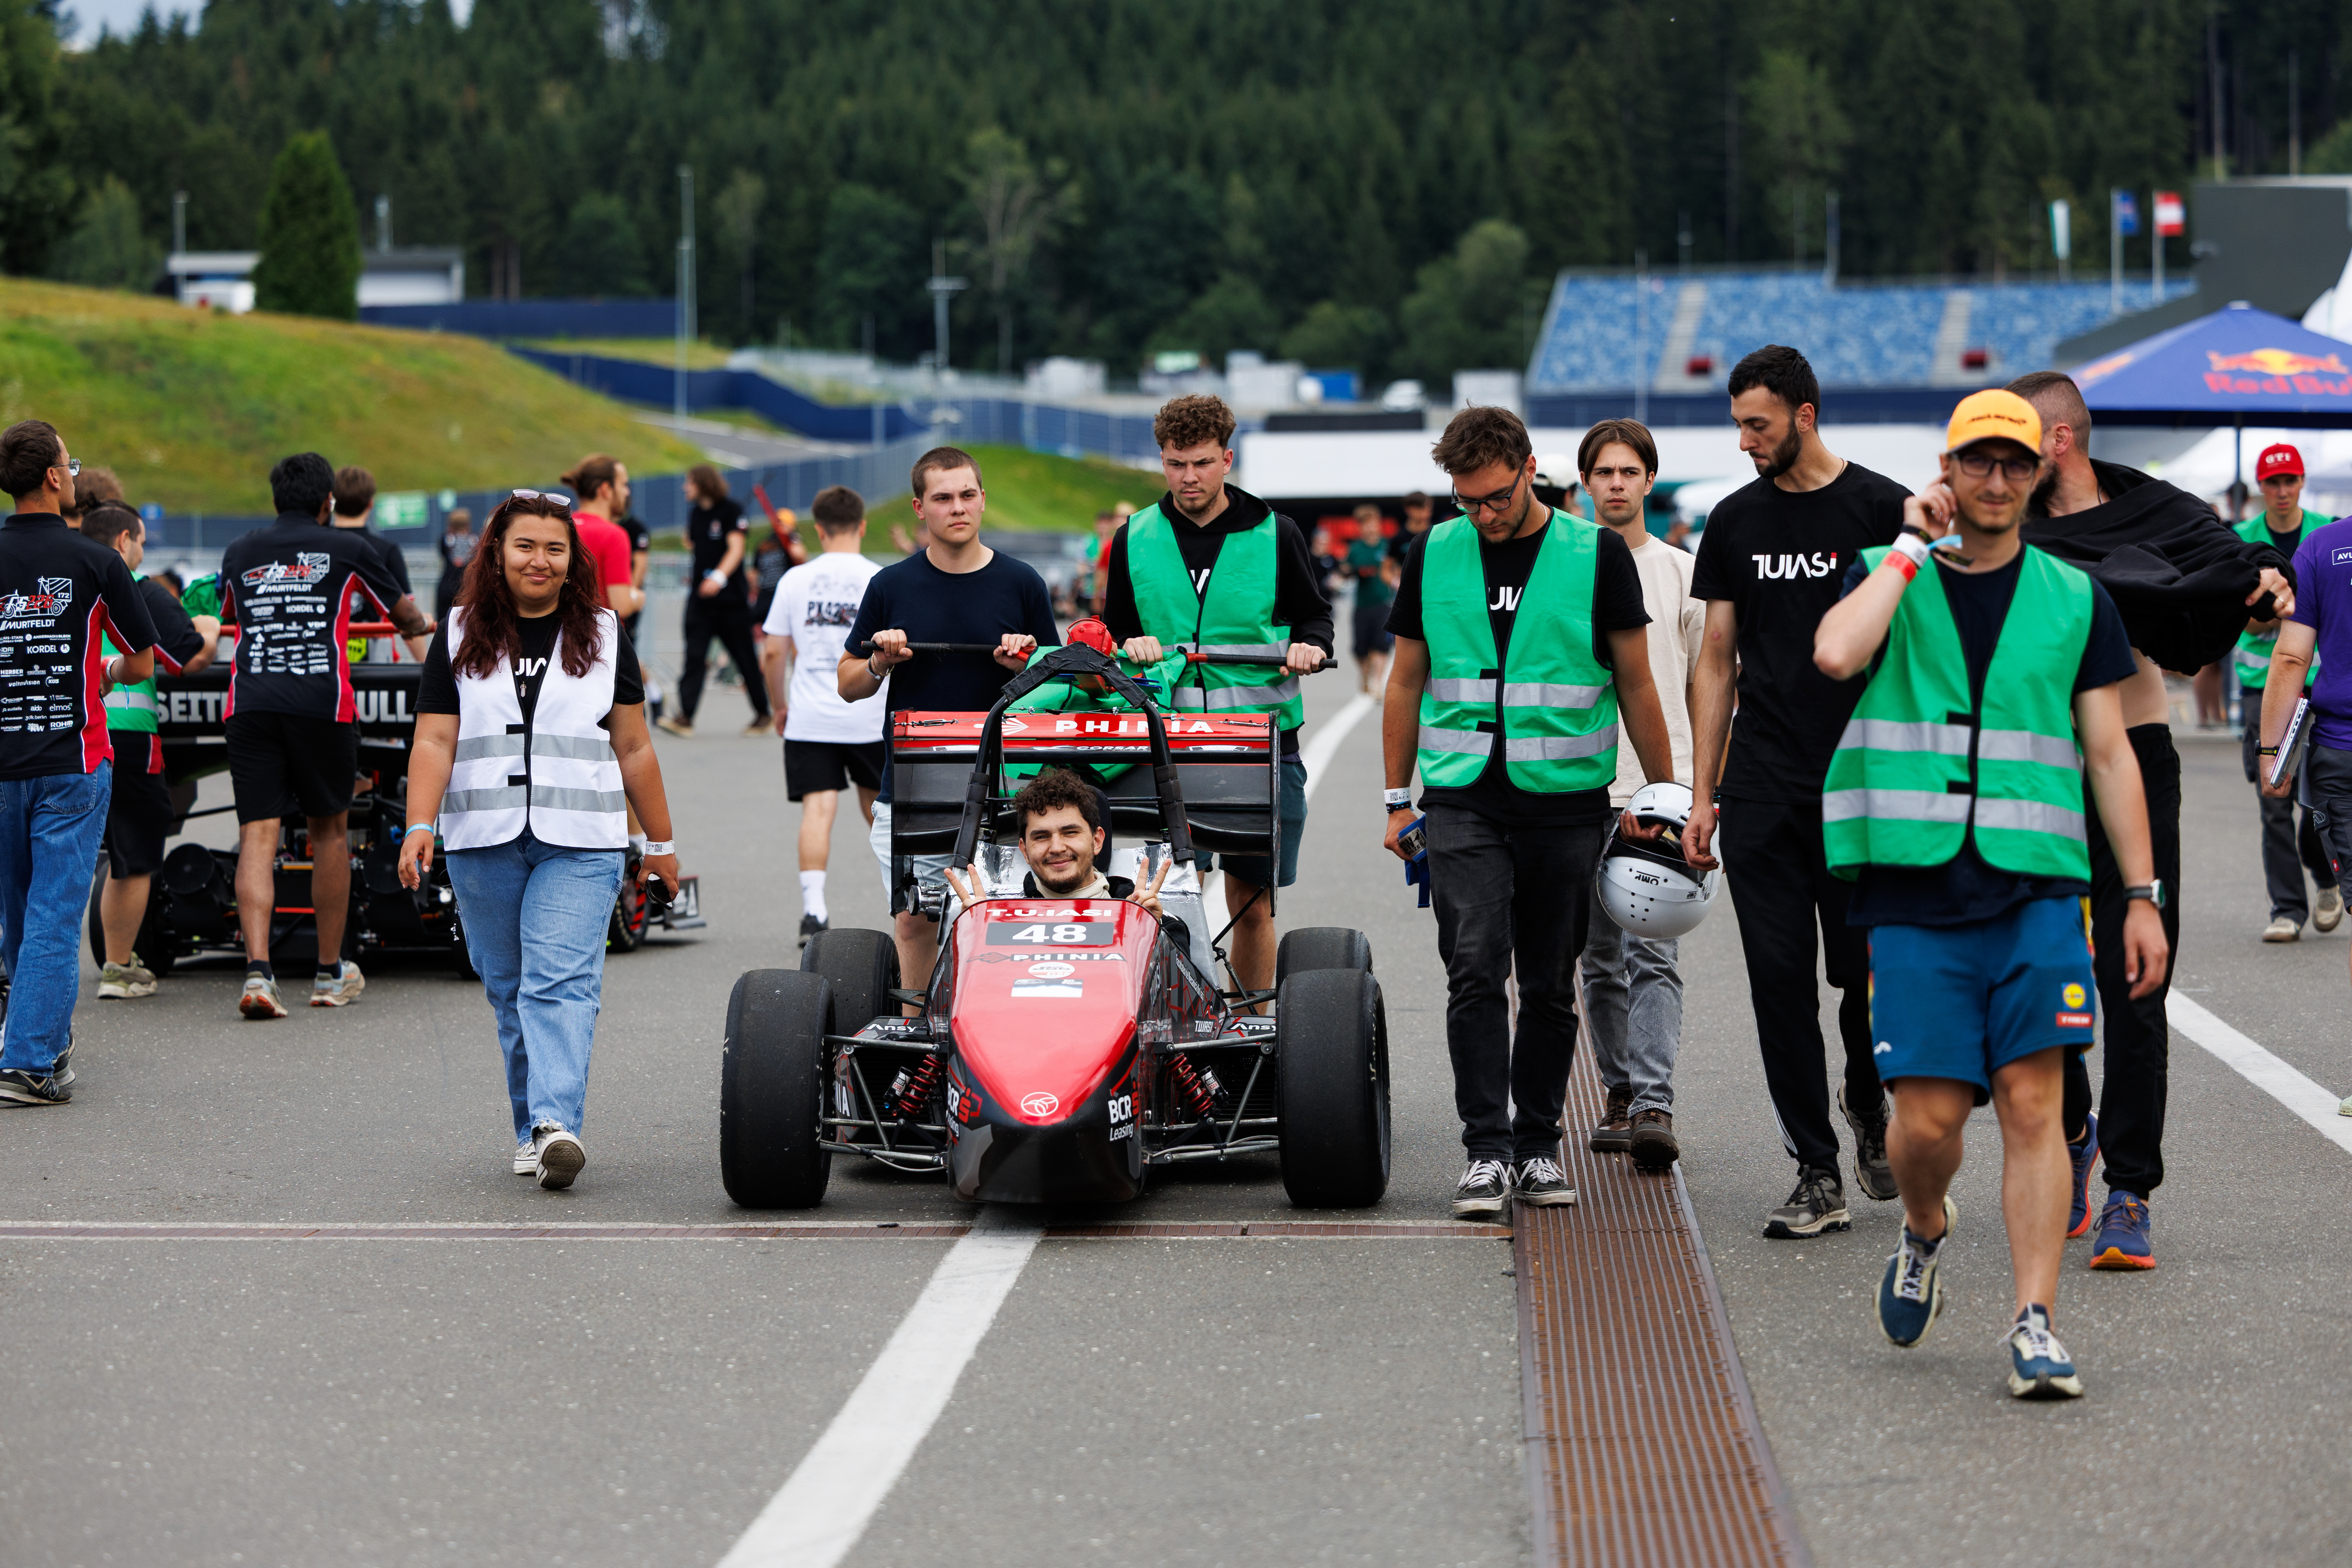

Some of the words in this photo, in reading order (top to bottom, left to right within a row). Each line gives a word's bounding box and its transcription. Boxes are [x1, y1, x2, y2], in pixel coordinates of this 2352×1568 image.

[286, 604, 314, 613] KORDEL
[5, 619, 55, 629] MURTFELDT
[27, 645, 57, 654] KORDEL
[356, 690, 414, 723] ULL
[1635, 874, 1659, 886] OMP
[1012, 924, 1087, 943] 48
[1013, 953, 1124, 962] PHINIA
[867, 1024, 917, 1032] Ansy
[948, 1082, 959, 1116] BCR
[1108, 1095, 1132, 1124] BCR
[1110, 1122, 1133, 1141] Leasing
